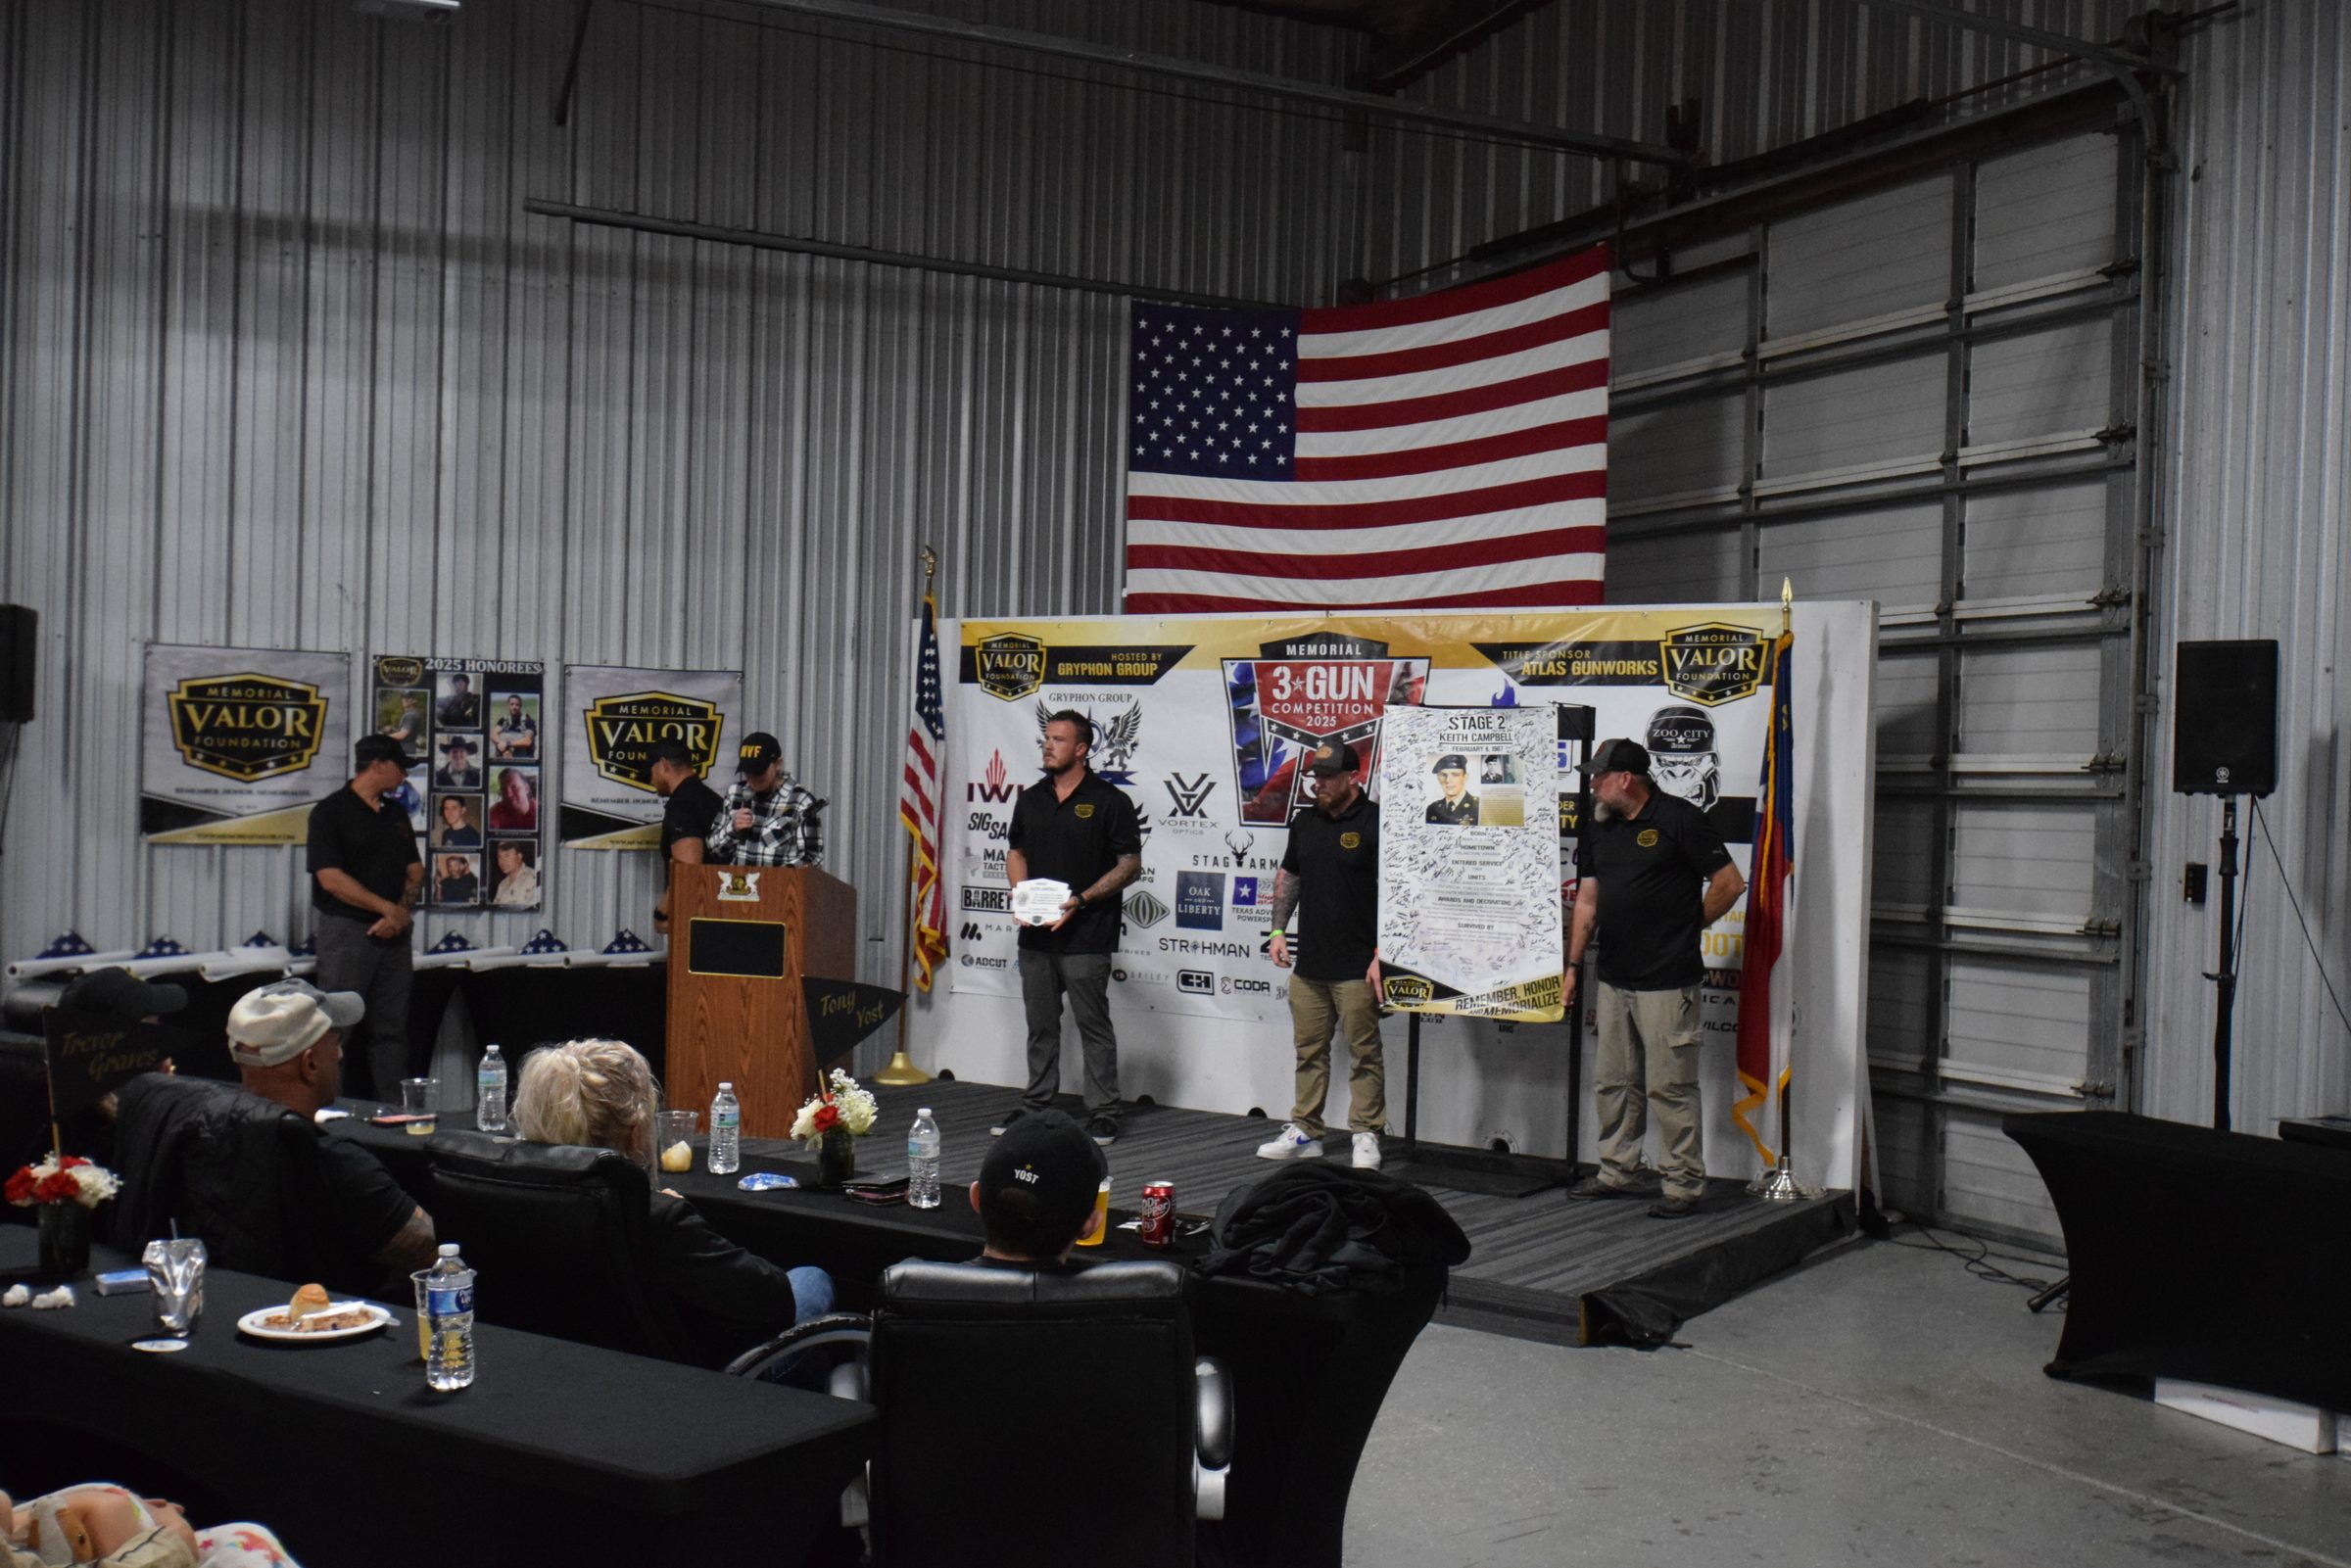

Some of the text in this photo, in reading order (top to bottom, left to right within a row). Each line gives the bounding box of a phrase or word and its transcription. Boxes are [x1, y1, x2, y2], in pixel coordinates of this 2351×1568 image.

[1685, 633, 1744, 643] MEMORIAL
[1286, 643, 1363, 656] MEMORIAL
[1503, 649, 1592, 660] TITLE SPONSOR
[981, 652, 1041, 673] VALOR
[1111, 652, 1148, 662] HOSTED
[1669, 646, 1758, 672] VALOR
[383, 665, 418, 676] VALOR
[424, 657, 542, 675] 2025 HONOREES
[1057, 662, 1159, 677] GRYPHON GROUP
[1521, 659, 1658, 676] ATLAS GUNWORKS
[1271, 665, 1374, 701] 3 GUN
[1676, 672, 1751, 682] FOUNDATION
[207, 687, 292, 700] MEMORIAL
[1048, 691, 1133, 704] GRYPHON GROUP
[618, 704, 693, 717] MEMORIAL
[1271, 702, 1374, 715] COMPETITION
[183, 703, 312, 737] VALOR
[1306, 716, 1337, 728] 2025
[1448, 715, 1506, 731] STAGE 2
[599, 721, 711, 752] VALOR
[1439, 733, 1513, 742] KEITH CAMPBELL
[1653, 729, 1710, 738] ZOO CITY
[193, 736, 302, 749] FOUNDATION
[740, 744, 762, 759] MVF
[968, 812, 992, 832] SIG
[1158, 819, 1220, 829] VORTEX
[1192, 854, 1279, 871] STAG ARM
[1188, 886, 1211, 897] OAK
[964, 889, 1012, 911] BARRET
[1177, 904, 1222, 916] LIBERTY
[975, 957, 1008, 969] ADCUT
[1234, 978, 1271, 992] CODA
[1389, 985, 1428, 999] VALOR
[1456, 975, 1561, 1012] REMEMBER, HONOR
[820, 989, 856, 1018] Tony
[1483, 991, 1560, 1017] MEMORIALIZE
[856, 999, 886, 1029] Yost
[62, 1031, 125, 1057] Trevor
[88, 1049, 160, 1082] Graves
[1014, 1168, 1039, 1184] YOST
[1147, 1197, 1160, 1208] Dr
